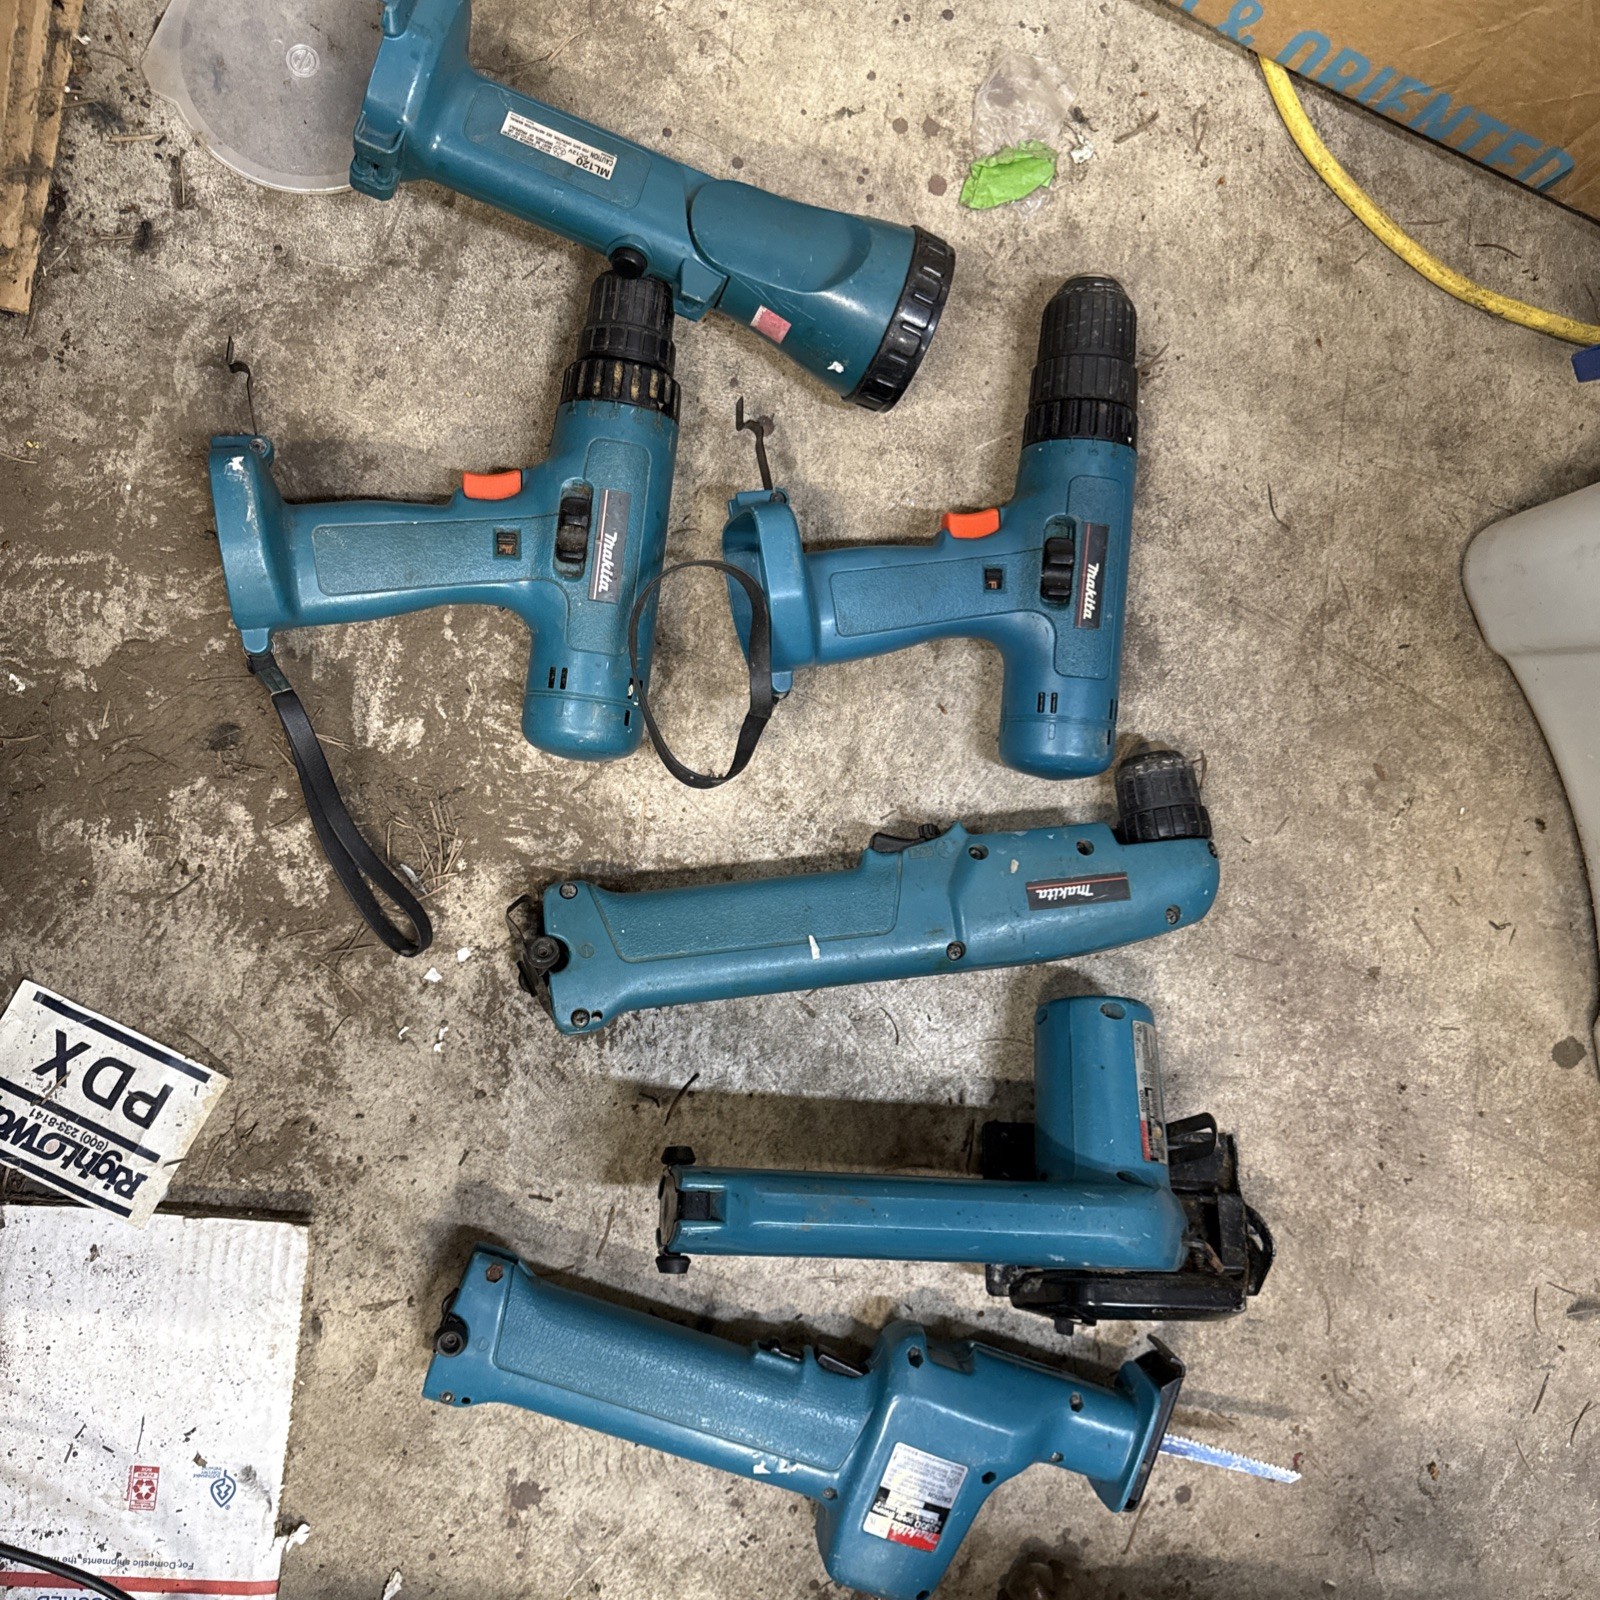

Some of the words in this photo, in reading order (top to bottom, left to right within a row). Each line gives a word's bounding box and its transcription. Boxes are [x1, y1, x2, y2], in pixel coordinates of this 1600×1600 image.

[576, 157, 610, 178] ML120
[590, 152, 614, 167] CAUTION
[32, 1029, 174, 1130] PDX
[29, 1108, 80, 1139] 233-8141
[80, 1131, 109, 1151] (800)
[62, 1556, 77, 1565] the
[132, 1559, 176, 1570] Domestic
[178, 1560, 194, 1570] For
